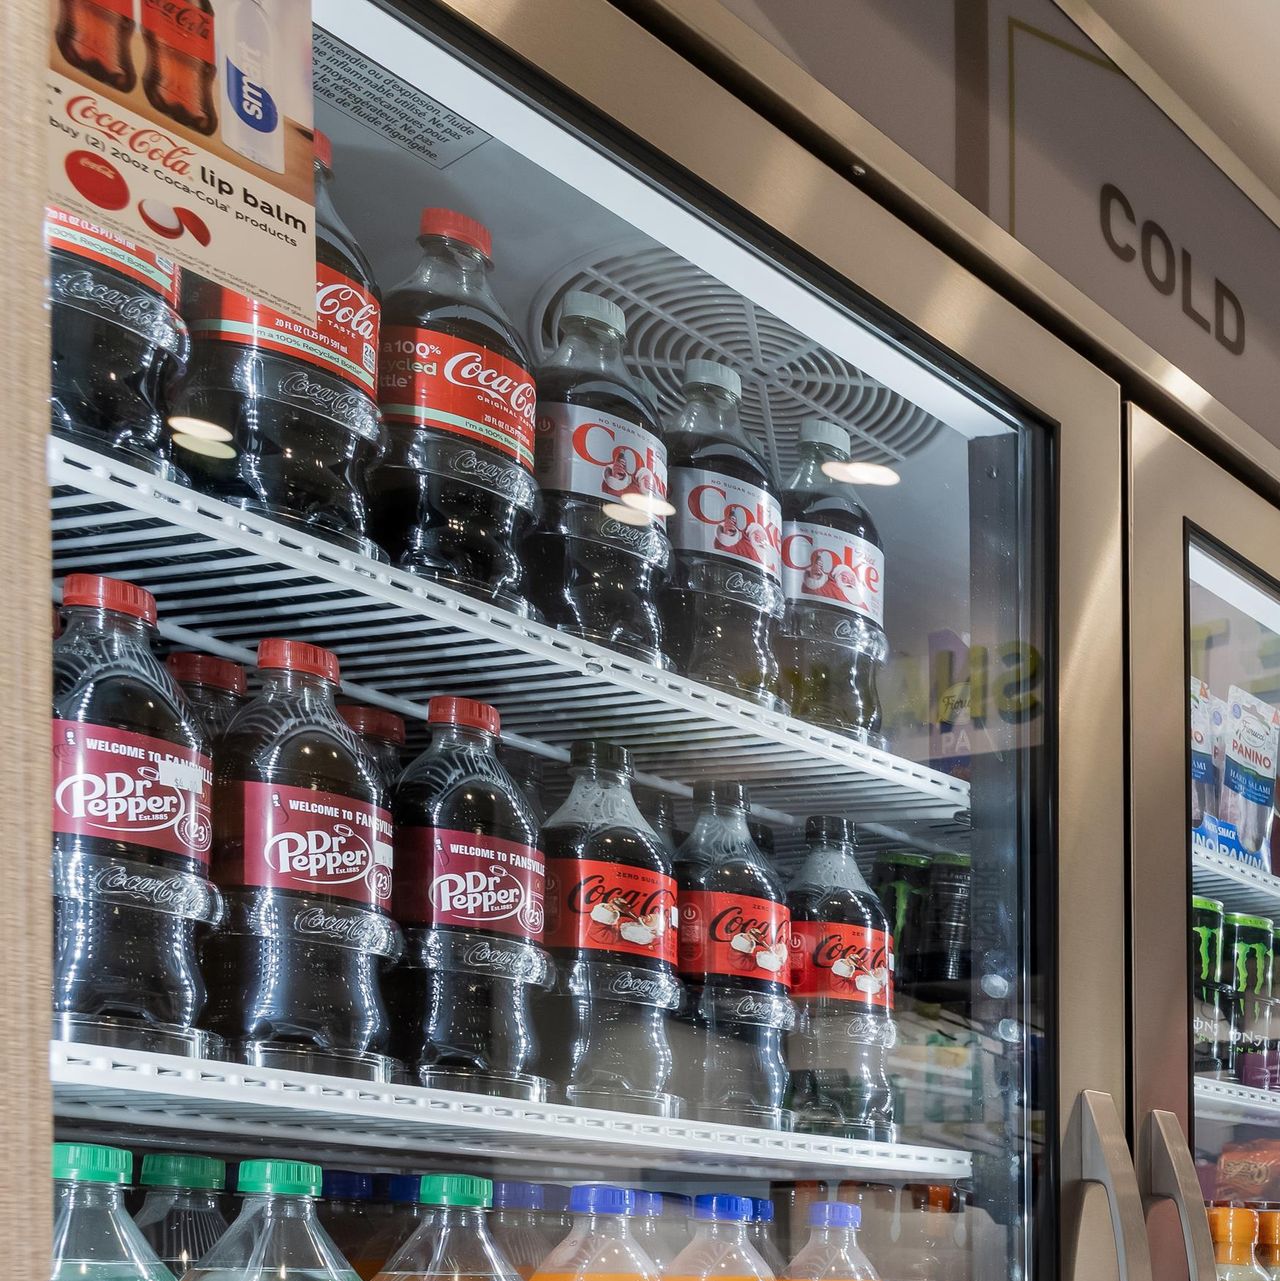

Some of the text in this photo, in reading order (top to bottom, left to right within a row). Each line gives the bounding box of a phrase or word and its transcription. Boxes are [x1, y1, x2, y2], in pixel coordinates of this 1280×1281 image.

[312, 33, 474, 136] d'incendie ou d'explosion. Fluide
[320, 64, 451, 144] moyens mécaniques pour
[326, 54, 394, 99] inflammable
[427, 116, 444, 130] Ne
[442, 126, 463, 141] pas
[318, 72, 434, 148] le Ne pas
[335, 97, 438, 160] de fluide frigorigène.
[49, 117, 297, 247] buy (2) 20oz products
[66, 95, 308, 234] Coca-Cola lip balm
[1100, 183, 1245, 356] COLD
[782, 533, 881, 593] Coke
[86, 738, 161, 763] WELCOME TO
[1232, 739, 1271, 769] PANINO
[56, 774, 178, 823] Pepper
[106, 773, 152, 798] Dr
[189, 822, 206, 843] 23
[289, 799, 353, 821] WELCOME TO
[264, 831, 366, 876] Pepper
[308, 831, 345, 853] Dr
[449, 844, 494, 860] WELCOME
[496, 851, 507, 862] TO
[375, 871, 388, 889] 23
[429, 872, 520, 914] Pepper
[471, 872, 501, 893] Dr
